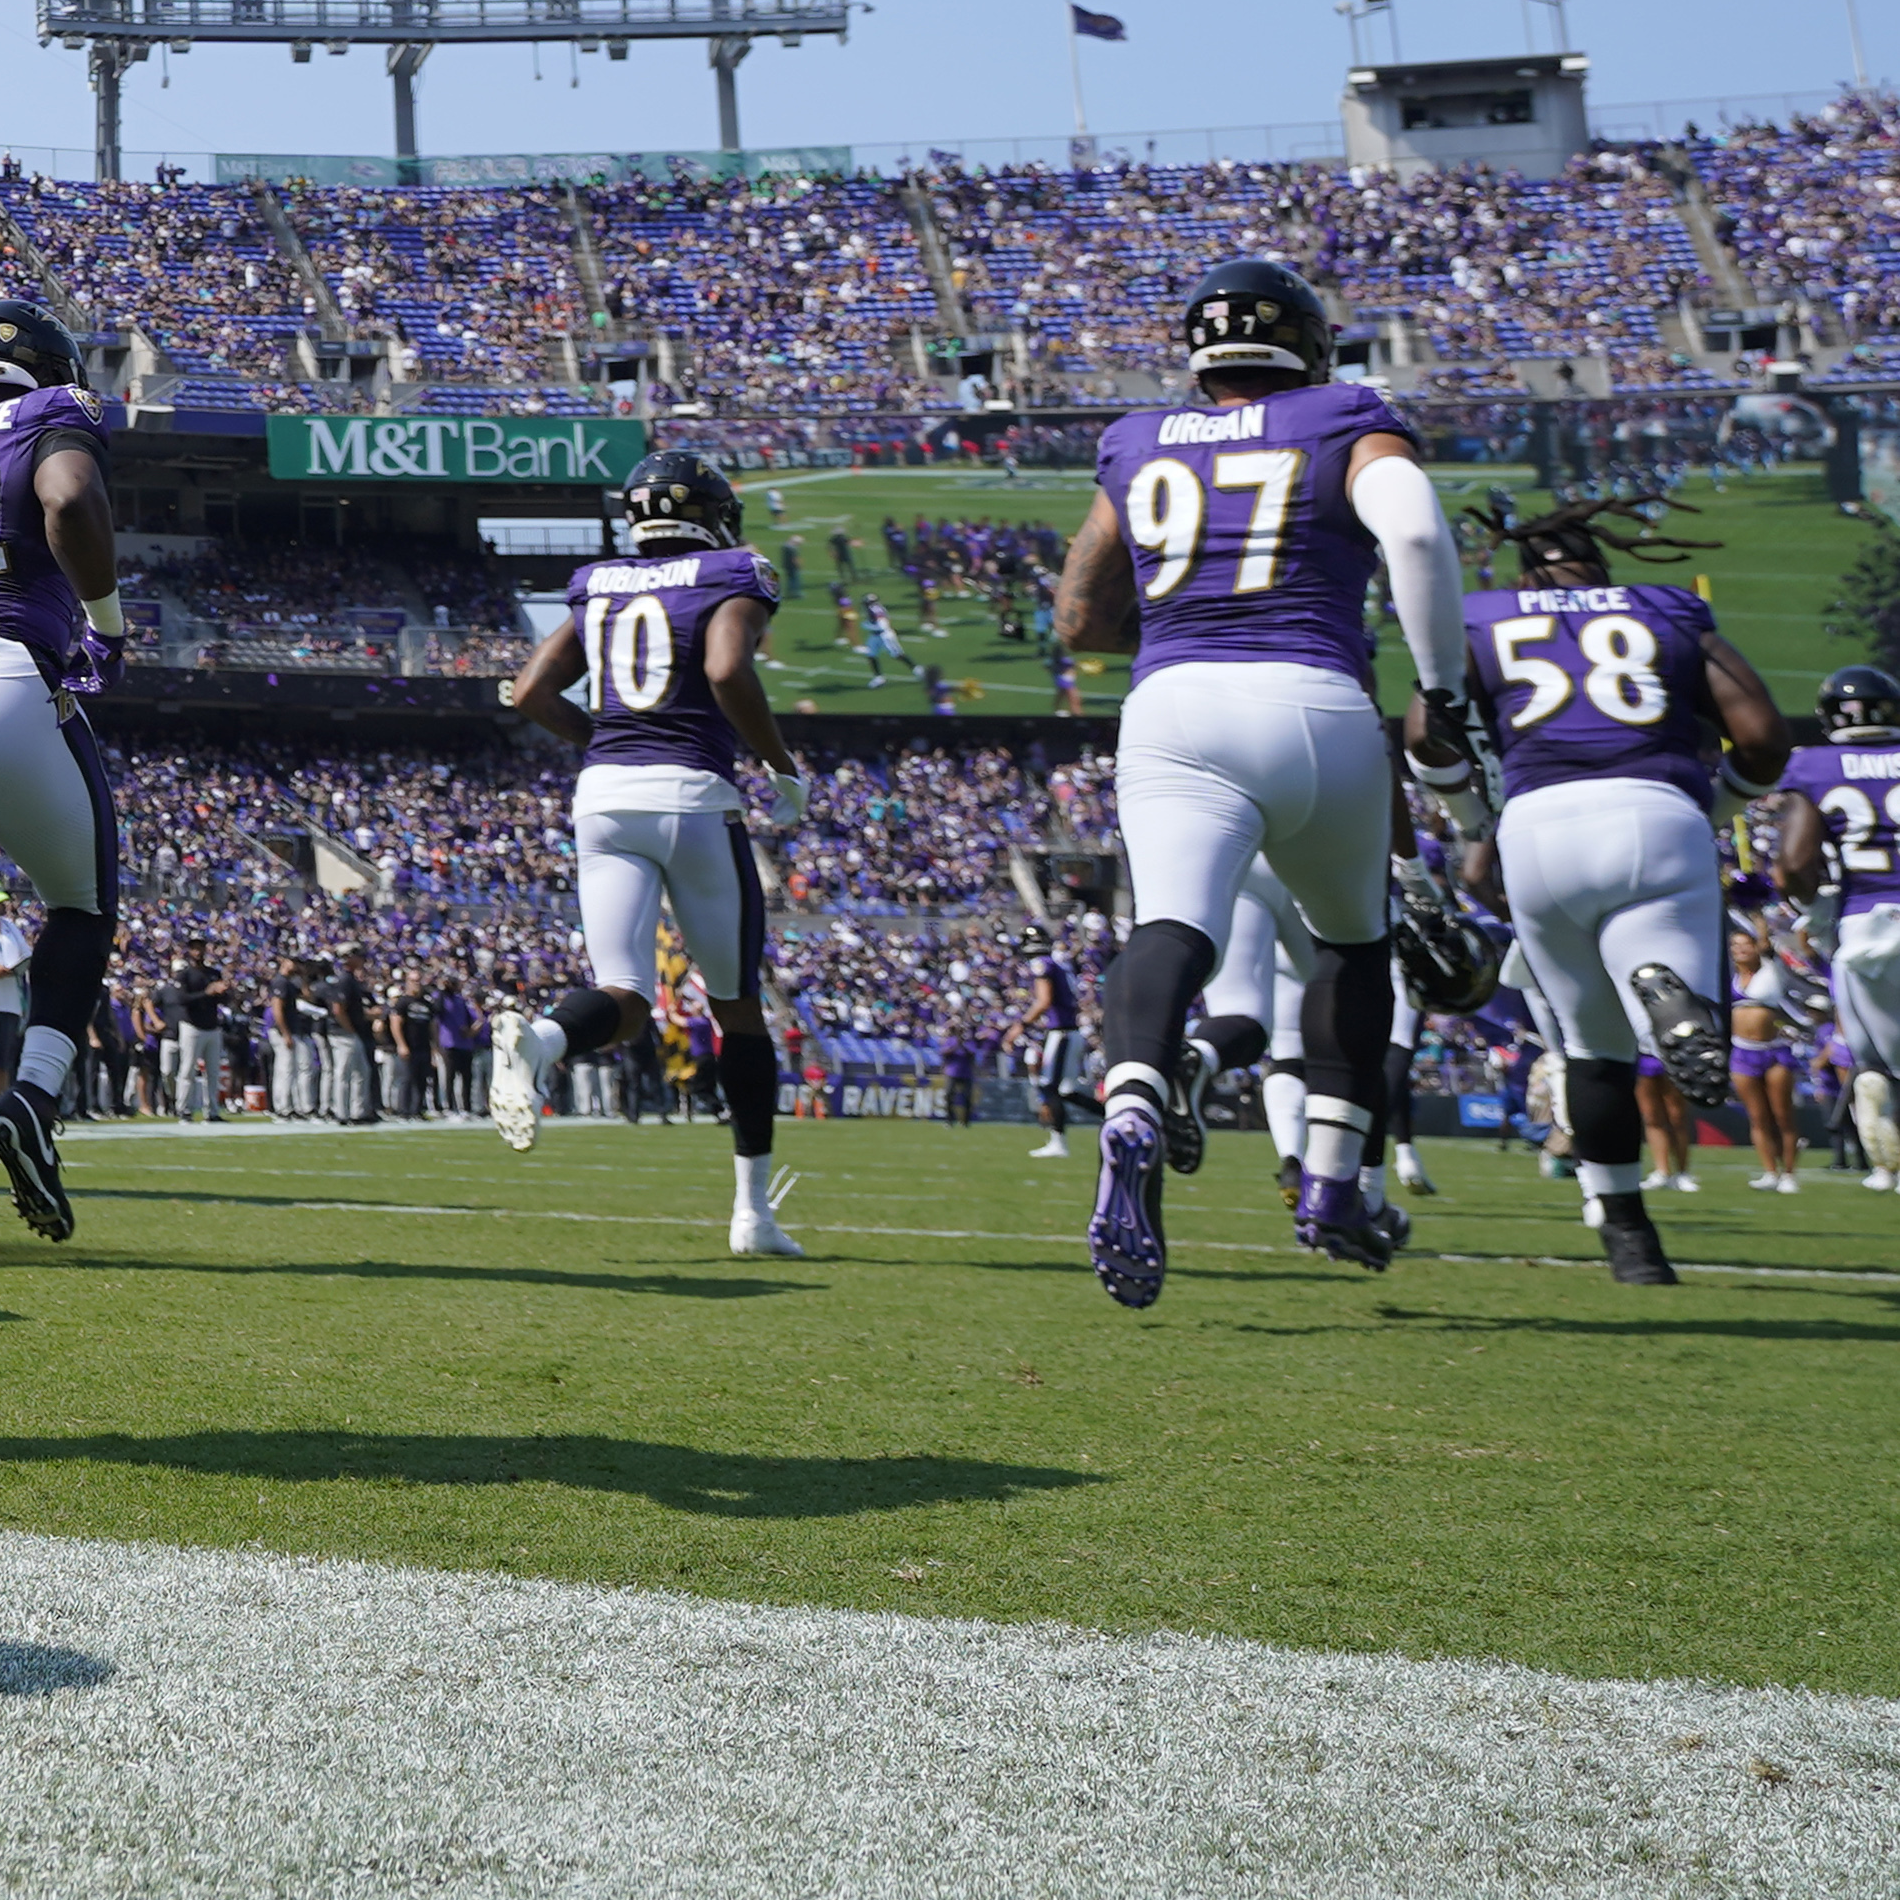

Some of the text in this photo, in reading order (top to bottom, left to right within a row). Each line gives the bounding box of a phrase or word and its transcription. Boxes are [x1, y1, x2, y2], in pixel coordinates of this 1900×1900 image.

[303, 419, 614, 480] M&T Bank
[1158, 403, 1266, 446] URBAN
[1125, 448, 1306, 600] 97
[586, 557, 702, 597] ROBINSON
[1517, 585, 1632, 614] PIERCE
[583, 593, 676, 714] 10
[1491, 614, 1668, 731] 58
[842, 1085, 949, 1118] RAVENS
